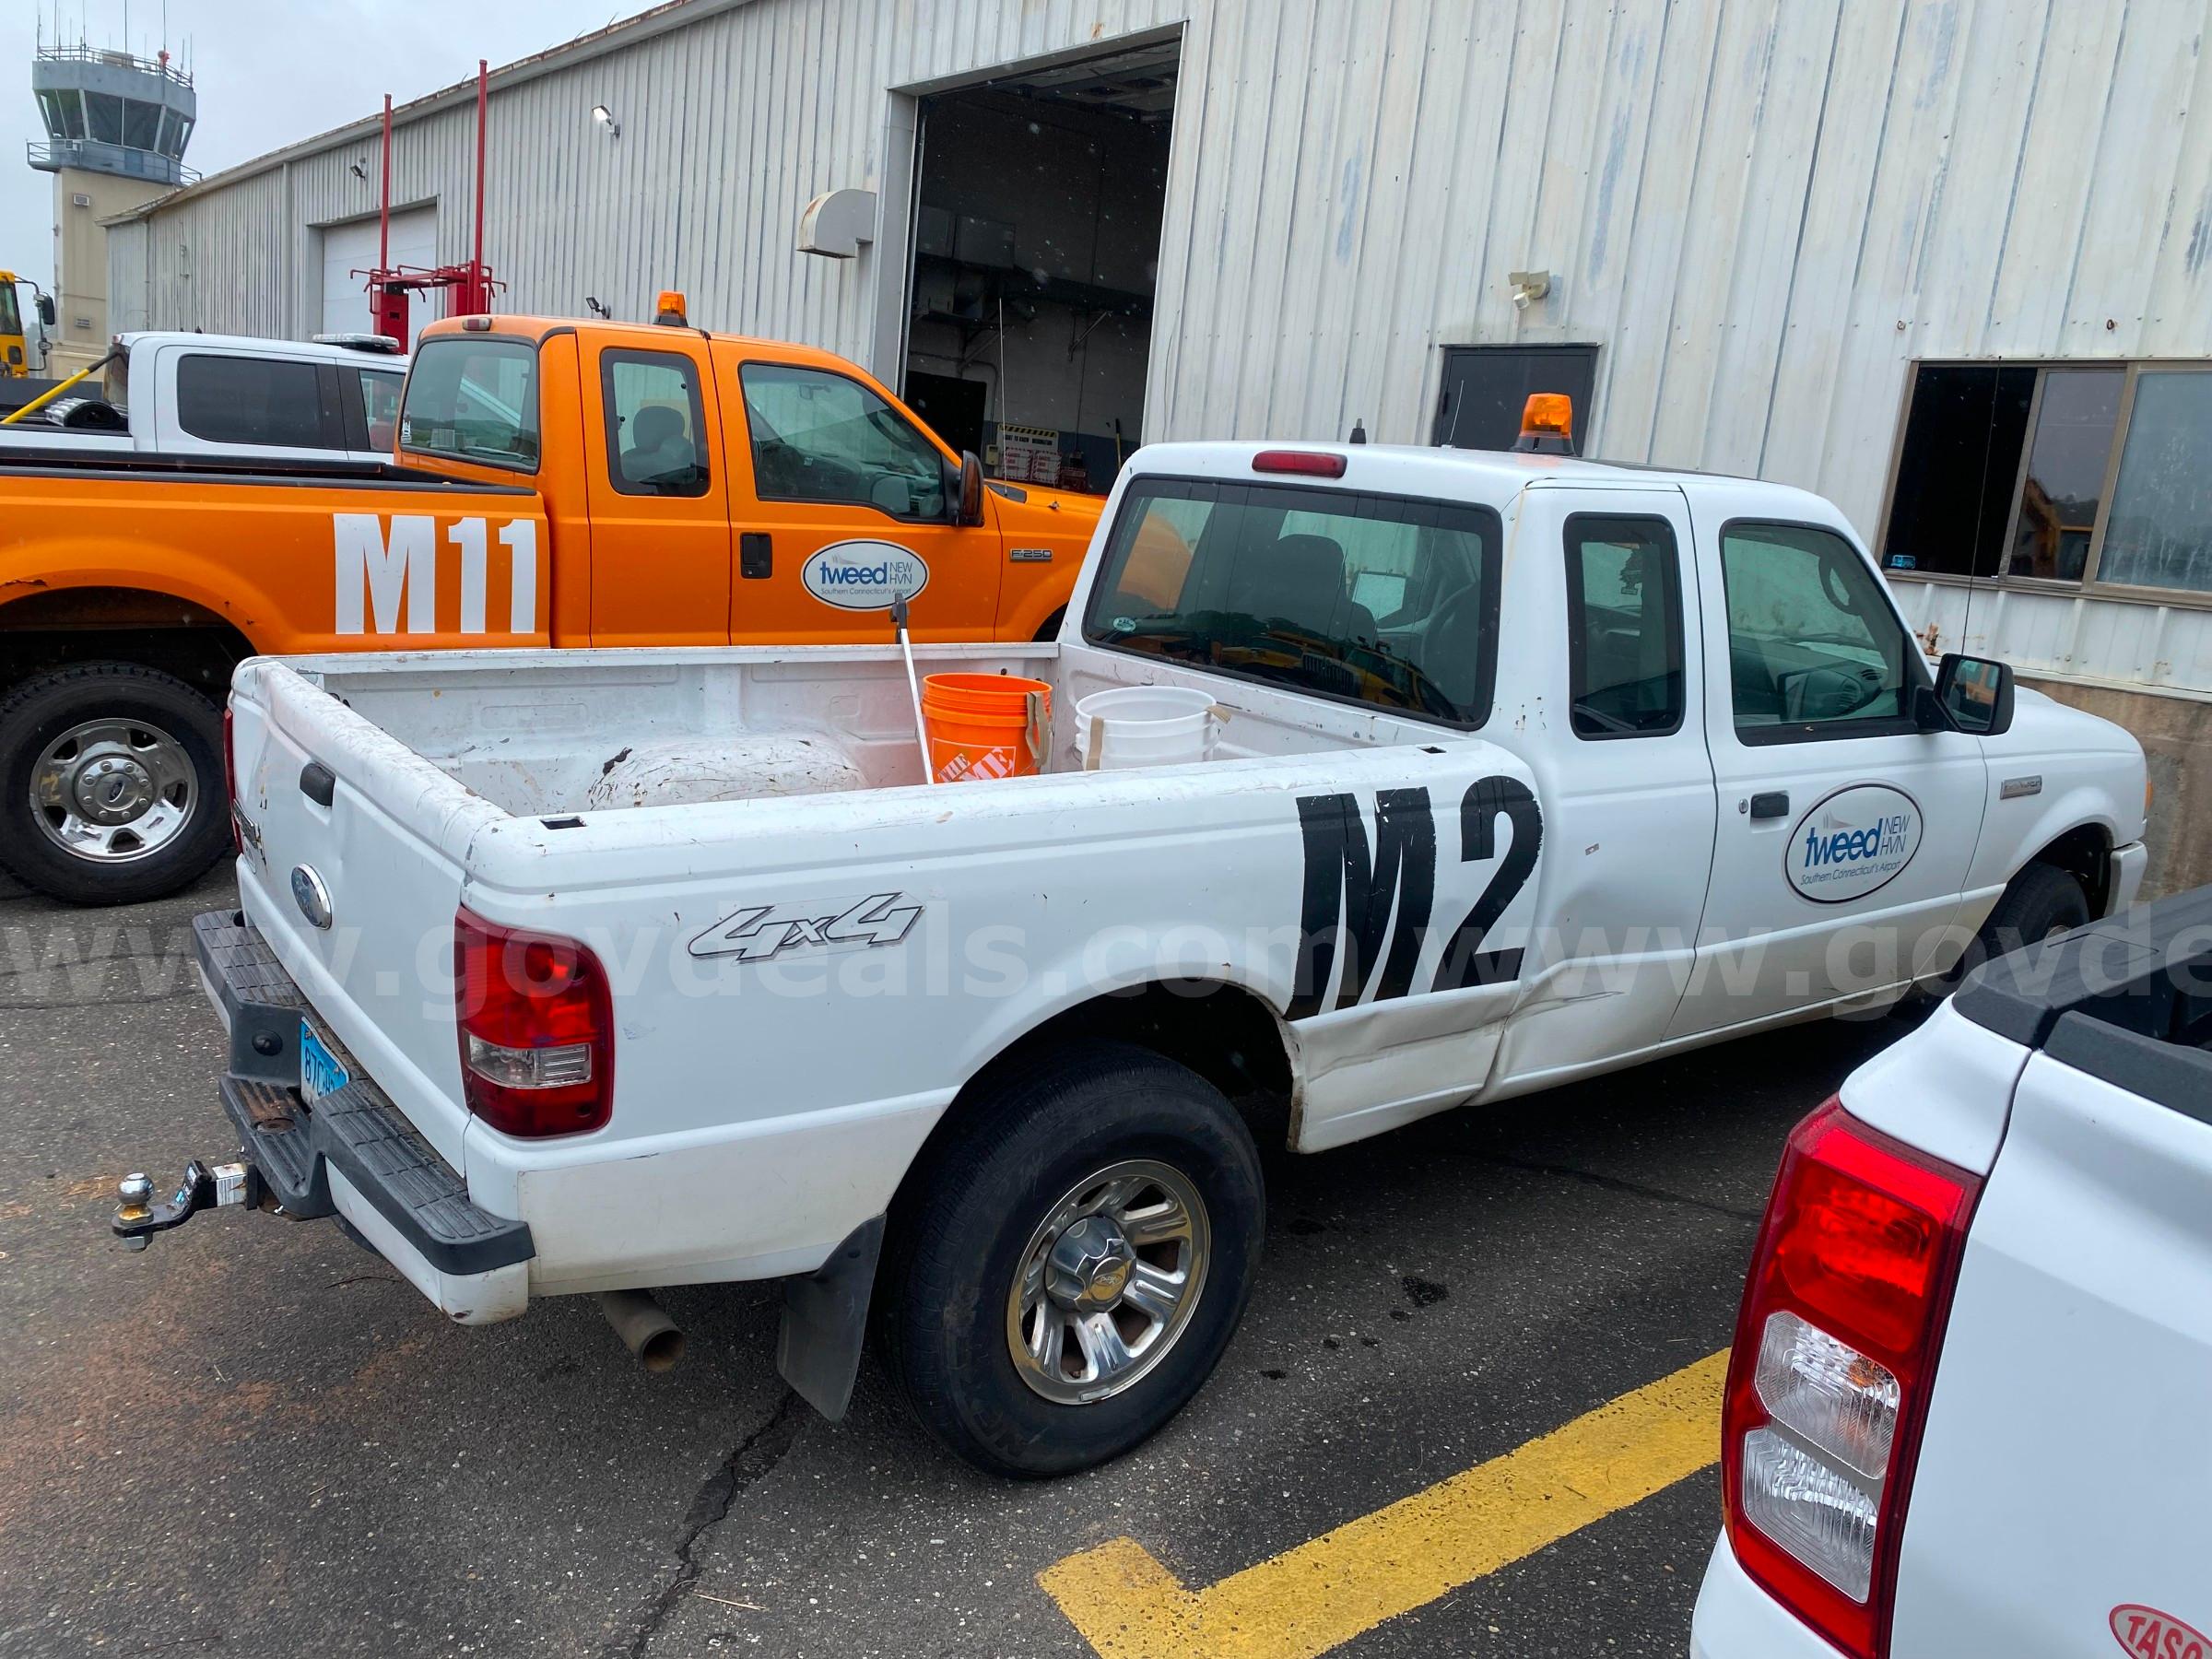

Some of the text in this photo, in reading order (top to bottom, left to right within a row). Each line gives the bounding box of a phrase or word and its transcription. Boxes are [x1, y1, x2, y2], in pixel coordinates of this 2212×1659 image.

[333, 512, 536, 634] M11
[819, 561, 888, 585] tweed
[889, 561, 912, 572] NEW
[889, 573, 912, 585] HVN
[1883, 815, 1911, 835] NEW
[1805, 818, 1883, 867] tweed
[1879, 834, 1907, 856] HVN
[1800, 860, 1902, 886] Southern Connecticut's Airport
[1281, 775, 1544, 1021] M2
[688, 891, 924, 964] 4x4
